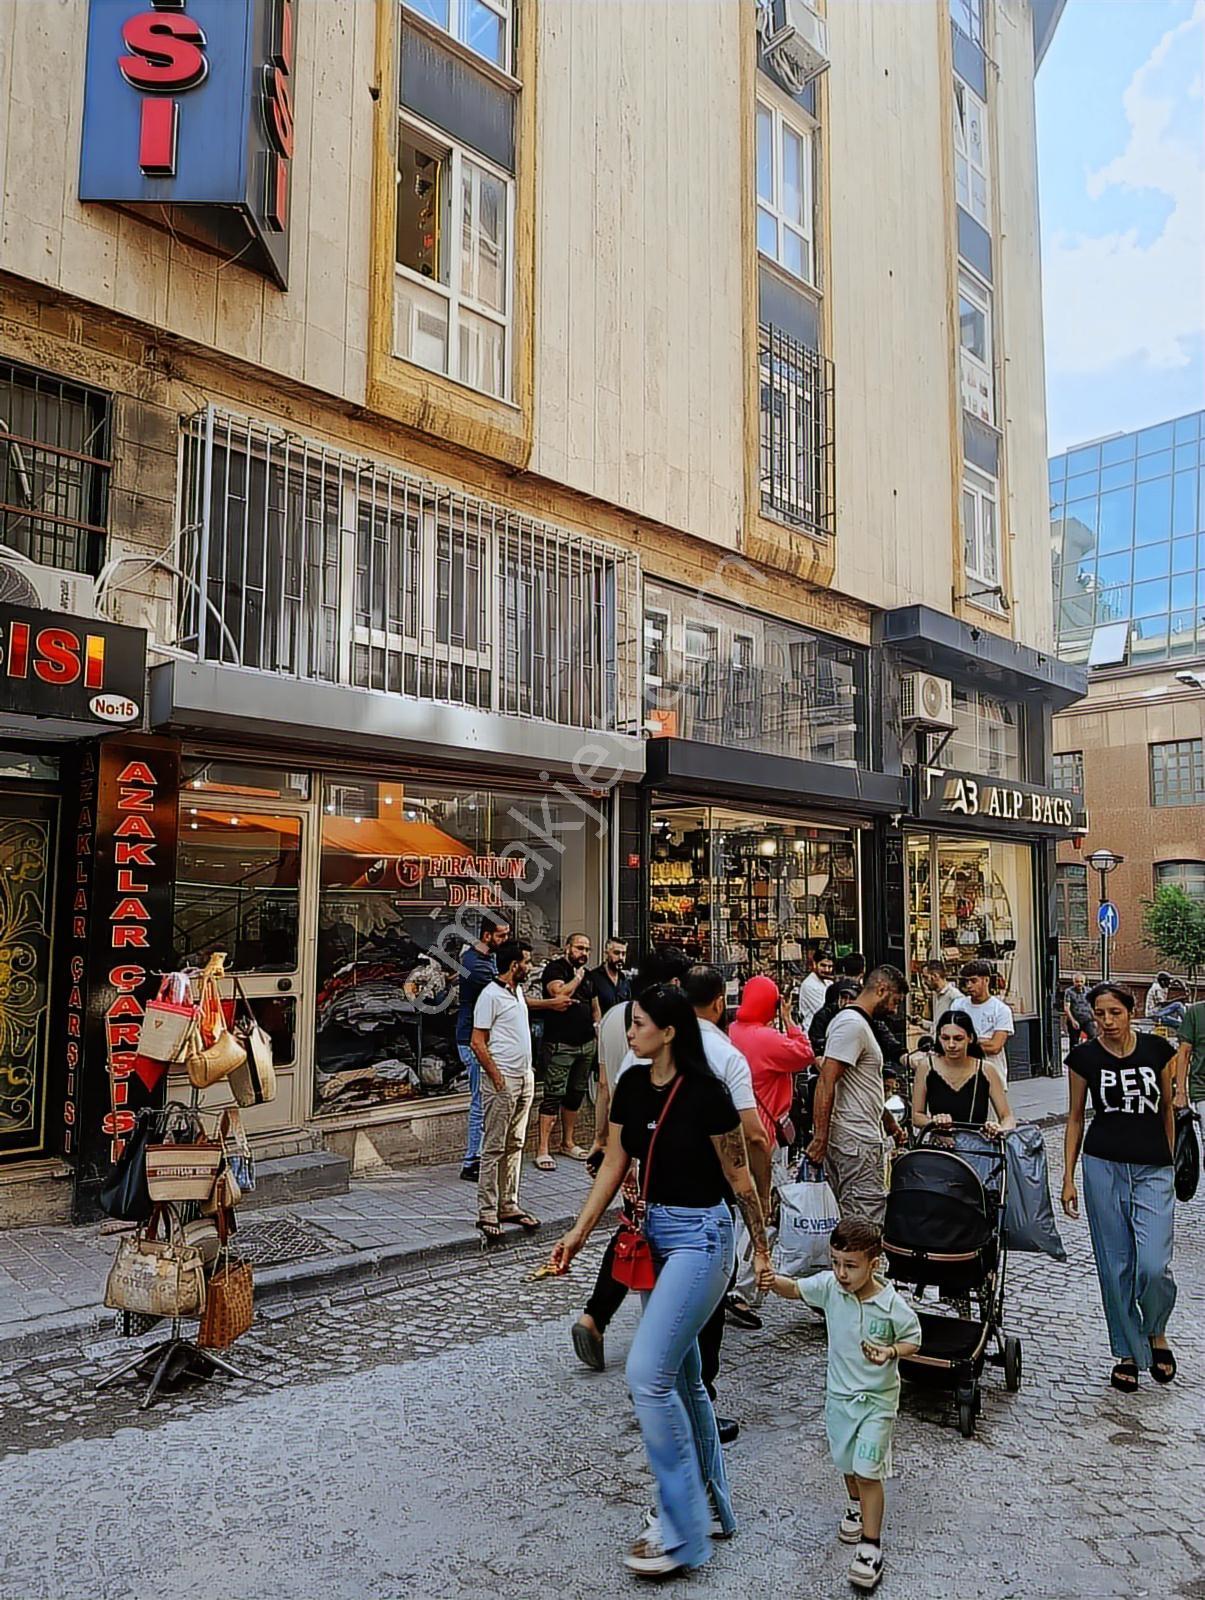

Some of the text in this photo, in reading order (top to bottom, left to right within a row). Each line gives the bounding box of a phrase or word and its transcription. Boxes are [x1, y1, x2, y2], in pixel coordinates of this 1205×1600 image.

[117, 0, 209, 175] SI
[0, 621, 105, 690] ISI
[95, 698, 134, 716] No:15
[988, 786, 1023, 820] ALP
[1031, 793, 1073, 827] BAGS
[74, 752, 95, 939] AZAKLAR
[109, 761, 158, 948] AZAKLAR
[448, 881, 502, 907] DERİ
[1100, 1066, 1161, 1097] BER
